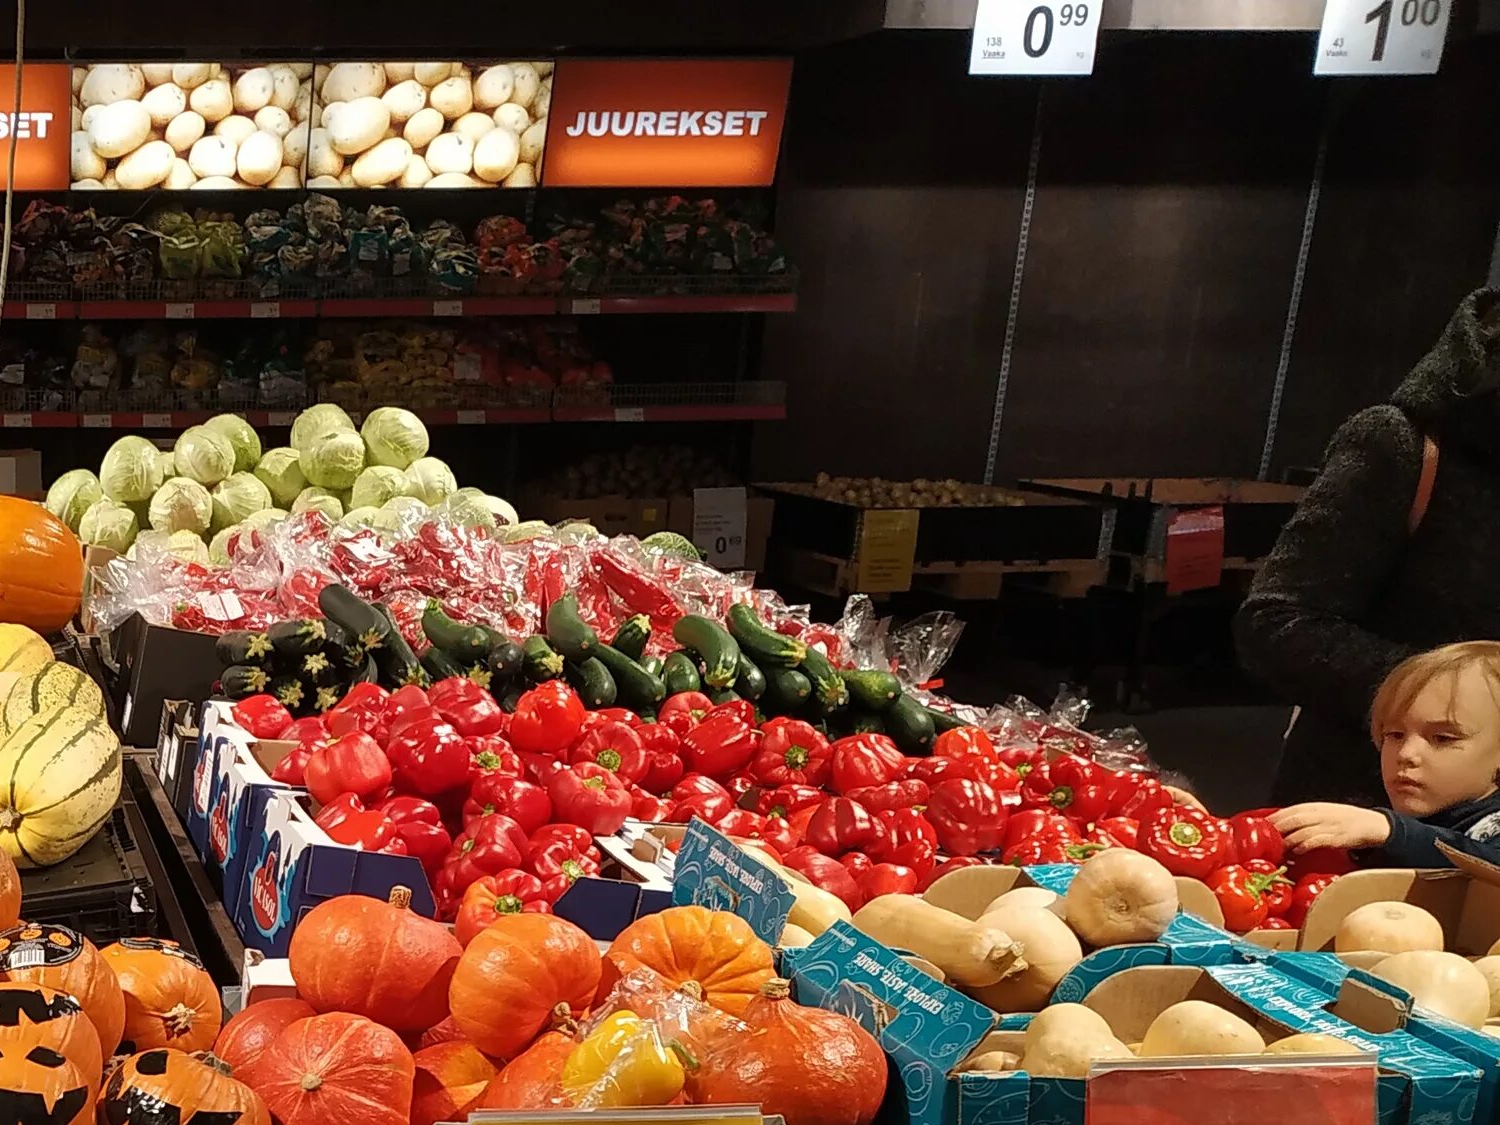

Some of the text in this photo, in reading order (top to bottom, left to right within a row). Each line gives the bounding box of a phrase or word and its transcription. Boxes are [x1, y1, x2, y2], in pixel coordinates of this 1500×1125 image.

[1023, 4, 1089, 58] 0 99
[1364, 0, 1440, 61] 1 00
[565, 110, 768, 137] JUUREKSET
